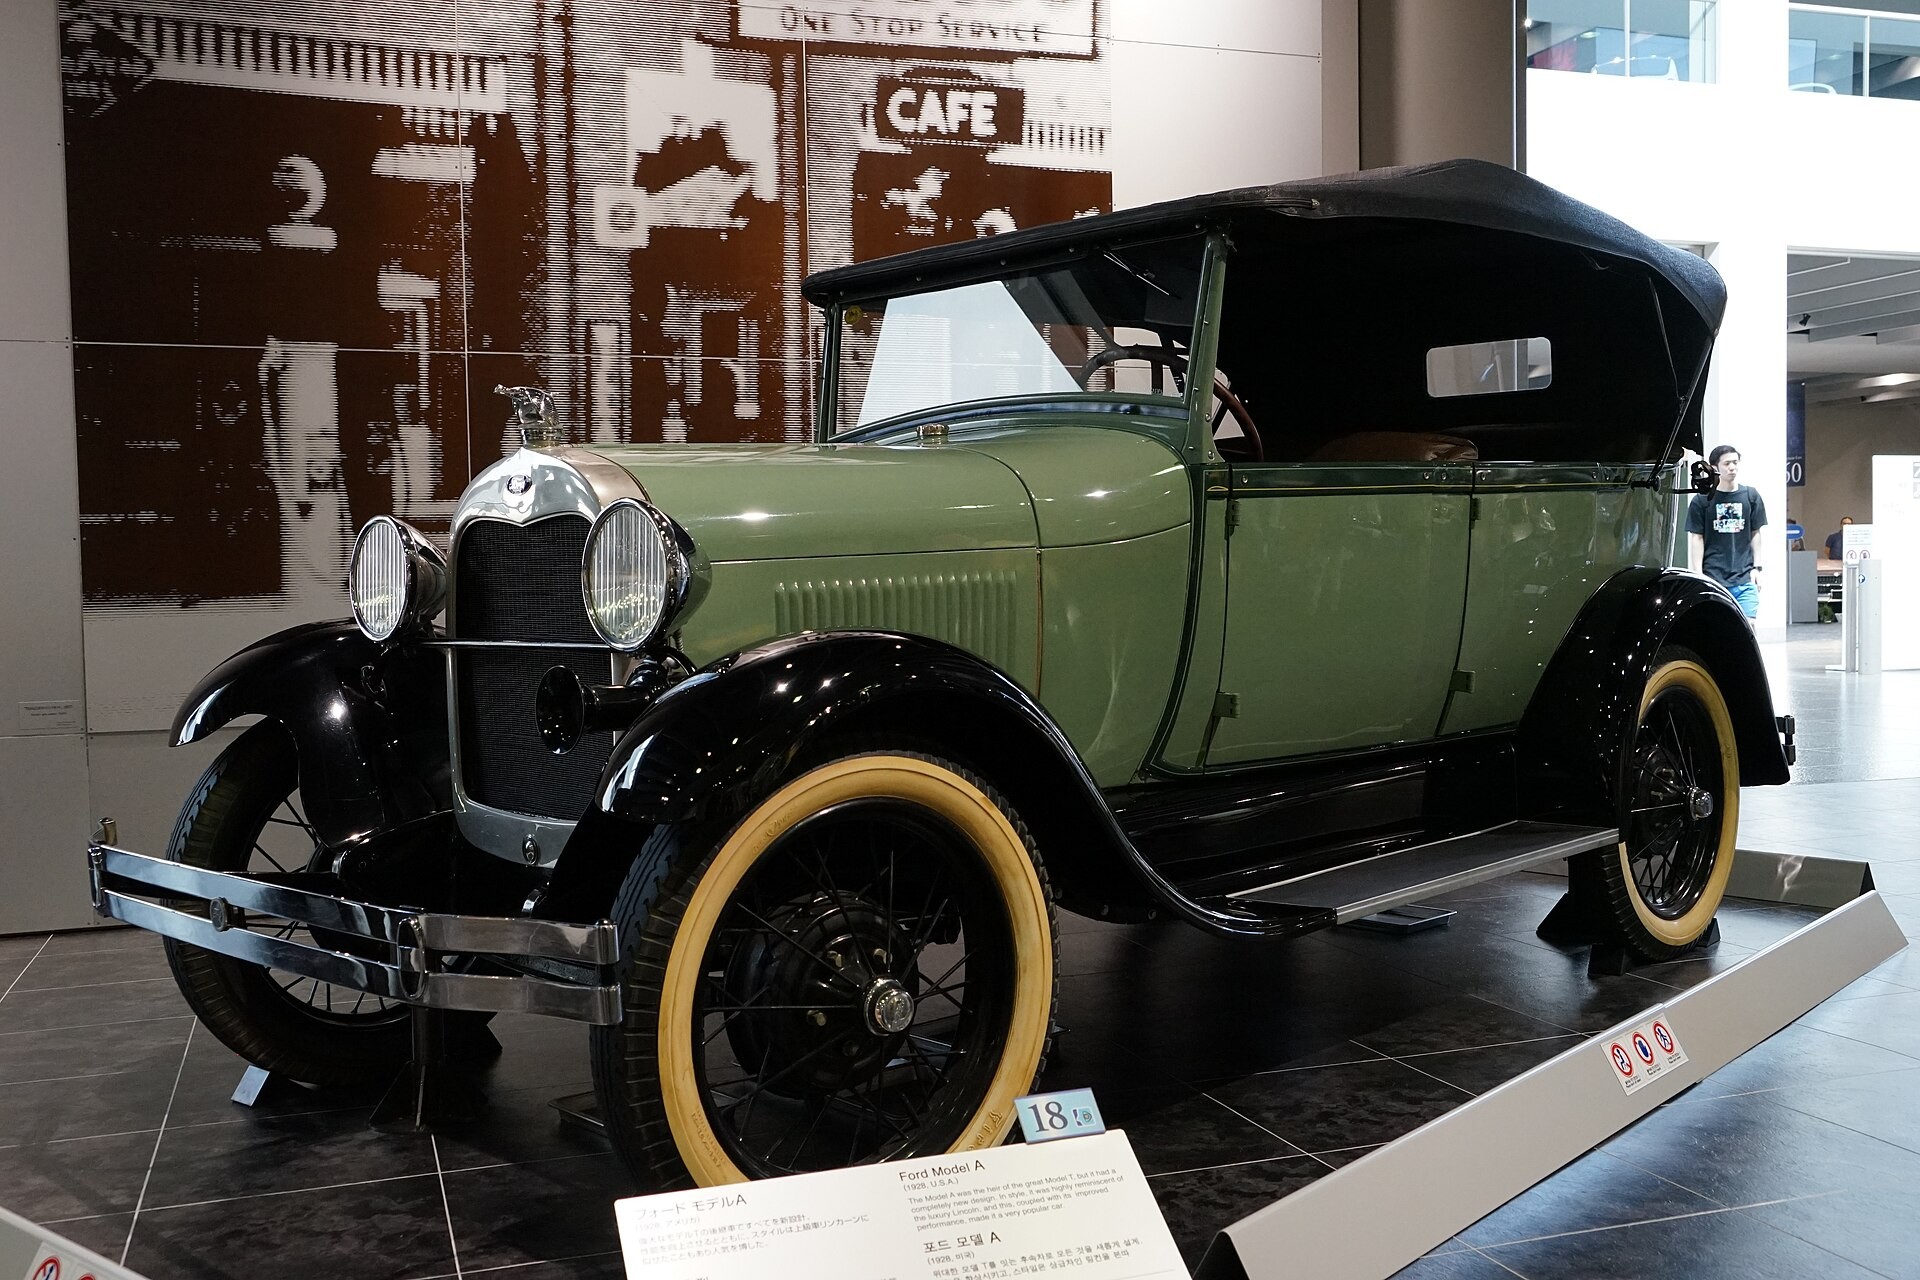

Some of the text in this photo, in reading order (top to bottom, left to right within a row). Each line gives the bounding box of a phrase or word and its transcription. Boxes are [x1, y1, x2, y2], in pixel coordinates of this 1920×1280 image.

[780, 6, 1042, 43] ONE STOP SERVICE
[885, 88, 998, 137] CAFE
[1028, 1101, 1068, 1133] 18
[899, 1160, 986, 1181] Ford Model A
[904, 1177, 959, 1192] (1928, U.S.A.)
[908, 1197, 923, 1205] The
[925, 1194, 948, 1204] Model
[986, 1185, 1000, 1193] heir
[1025, 1179, 1044, 1188] great
[1045, 1176, 1068, 1184] Model
[1077, 1172, 1088, 1180] but
[912, 1201, 952, 1214] completely
[1008, 1190, 1028, 1200] style,
[1052, 1184, 1072, 1193] highly
[1074, 1177, 1116, 1188] reminiscent
[634, 1194, 748, 1220] フォード モデルA
[914, 1214, 926, 1222] the
[928, 1211, 951, 1220] luxury
[952, 1206, 981, 1217] Lincoln,
[984, 1203, 998, 1212] and
[999, 1201, 1014, 1209] this,
[1016, 1196, 1046, 1207] coupled
[1075, 1187, 1109, 1198] improved
[916, 1218, 966, 1232] performance,
[968, 1214, 990, 1222] made
[1004, 1210, 1020, 1218] very
[1022, 1206, 1049, 1216] popular
[924, 1232, 1001, 1253] 포드 모델 A
[928, 1251, 975, 1265] (1928, 미국)
[962, 1264, 979, 1274] 모델
